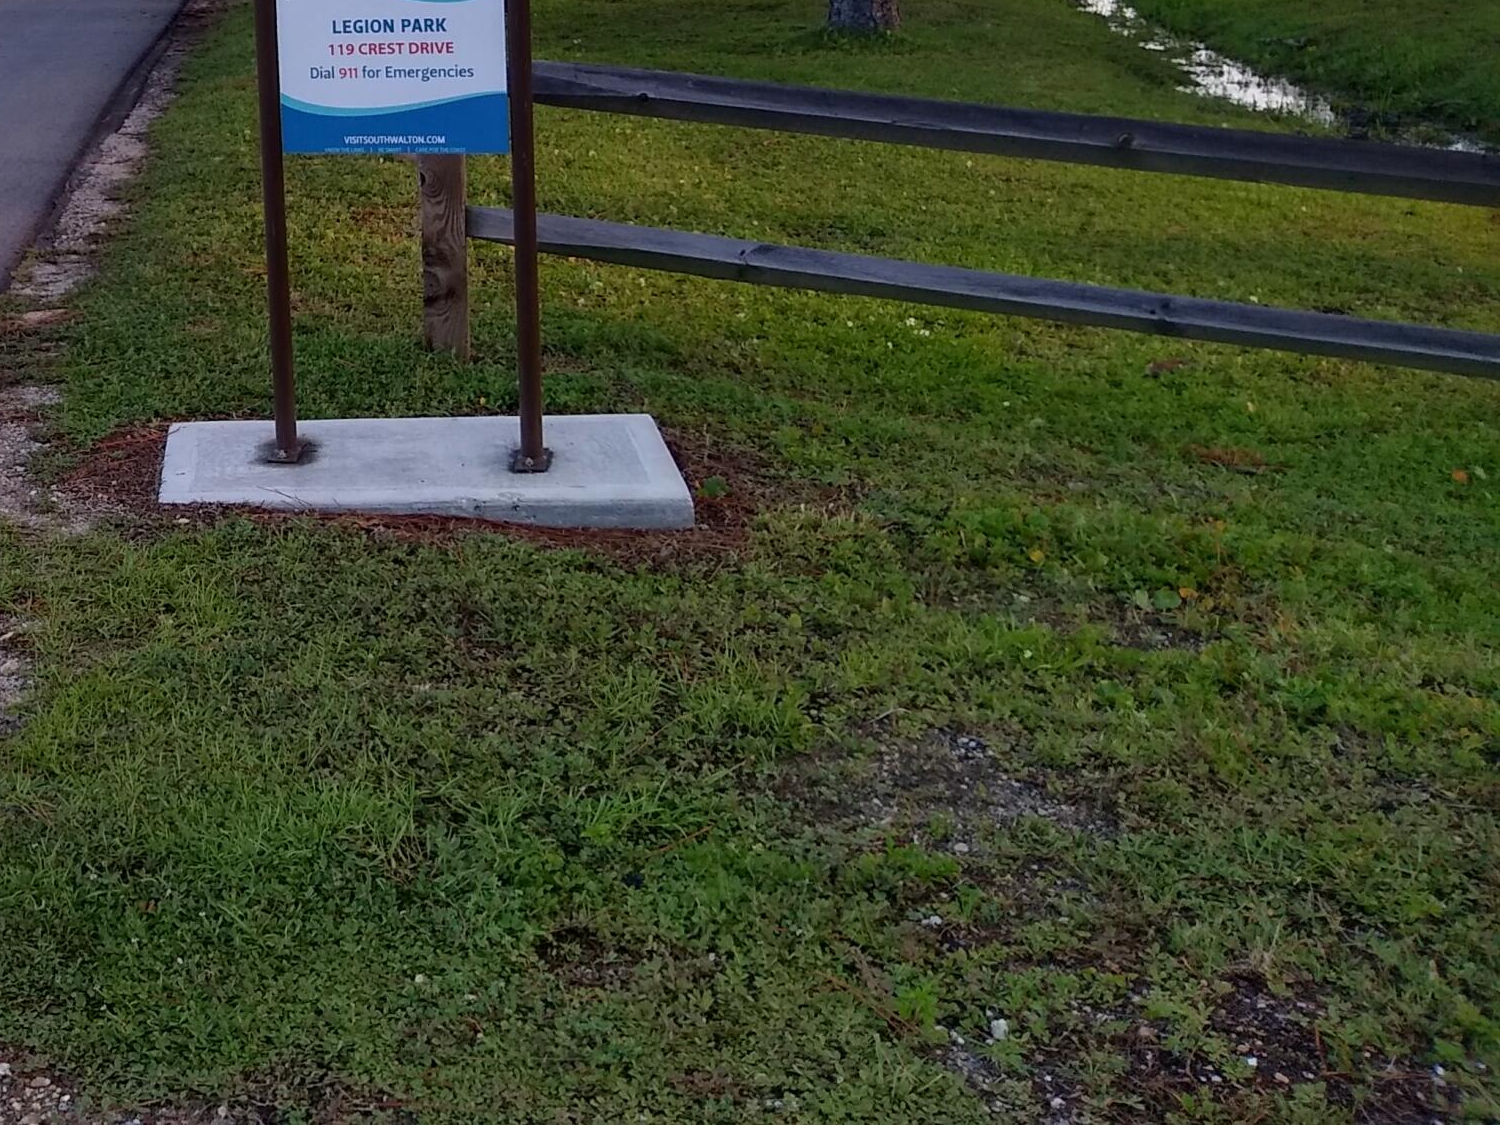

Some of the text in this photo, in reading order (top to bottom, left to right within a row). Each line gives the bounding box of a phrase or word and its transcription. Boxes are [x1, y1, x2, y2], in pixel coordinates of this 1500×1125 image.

[332, 17, 447, 34] LEGION PARK
[328, 41, 454, 56] 119 CREST DRIVE
[310, 64, 474, 82] Dial 911 for Emergencies
[343, 135, 446, 145] VISITSOUTHWALTON.COM
